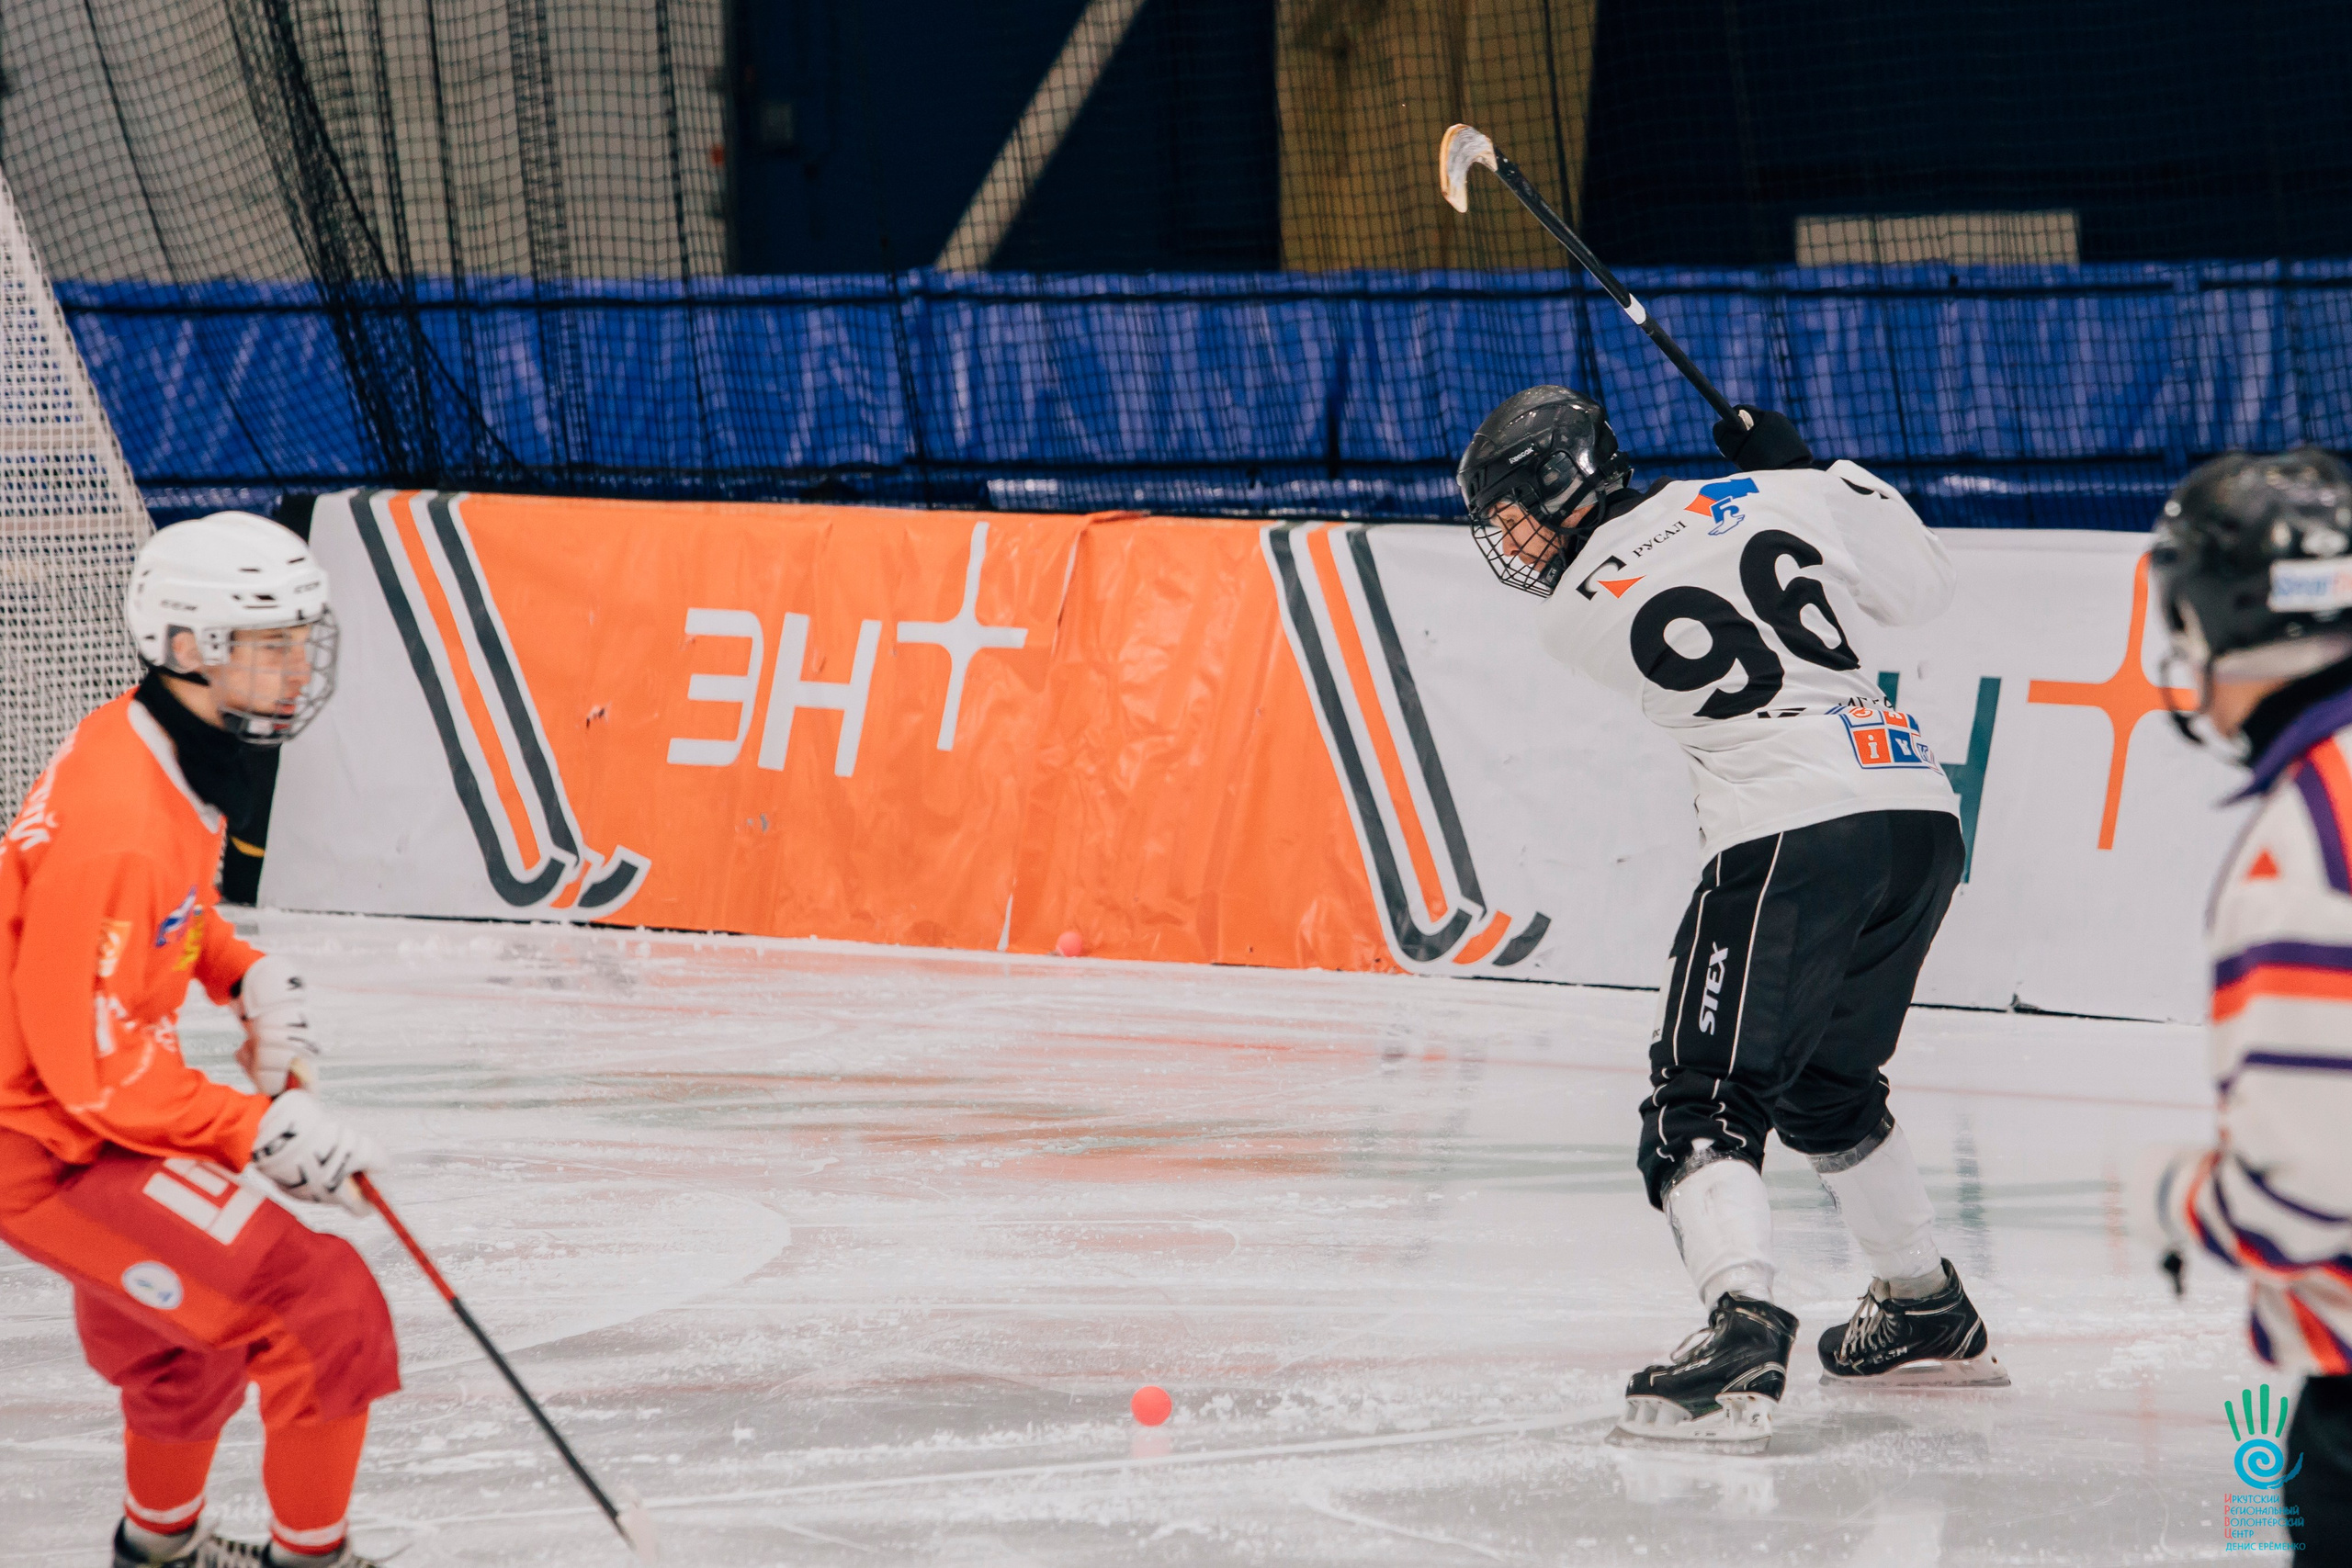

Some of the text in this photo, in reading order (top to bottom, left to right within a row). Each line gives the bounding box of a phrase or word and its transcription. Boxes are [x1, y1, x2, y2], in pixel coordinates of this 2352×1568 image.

[1508, 446, 1534, 464] Reebok
[1633, 521, 1688, 558] РУСАЛ
[1630, 529, 1860, 719] 96
[1699, 942, 1728, 1036] STEX
